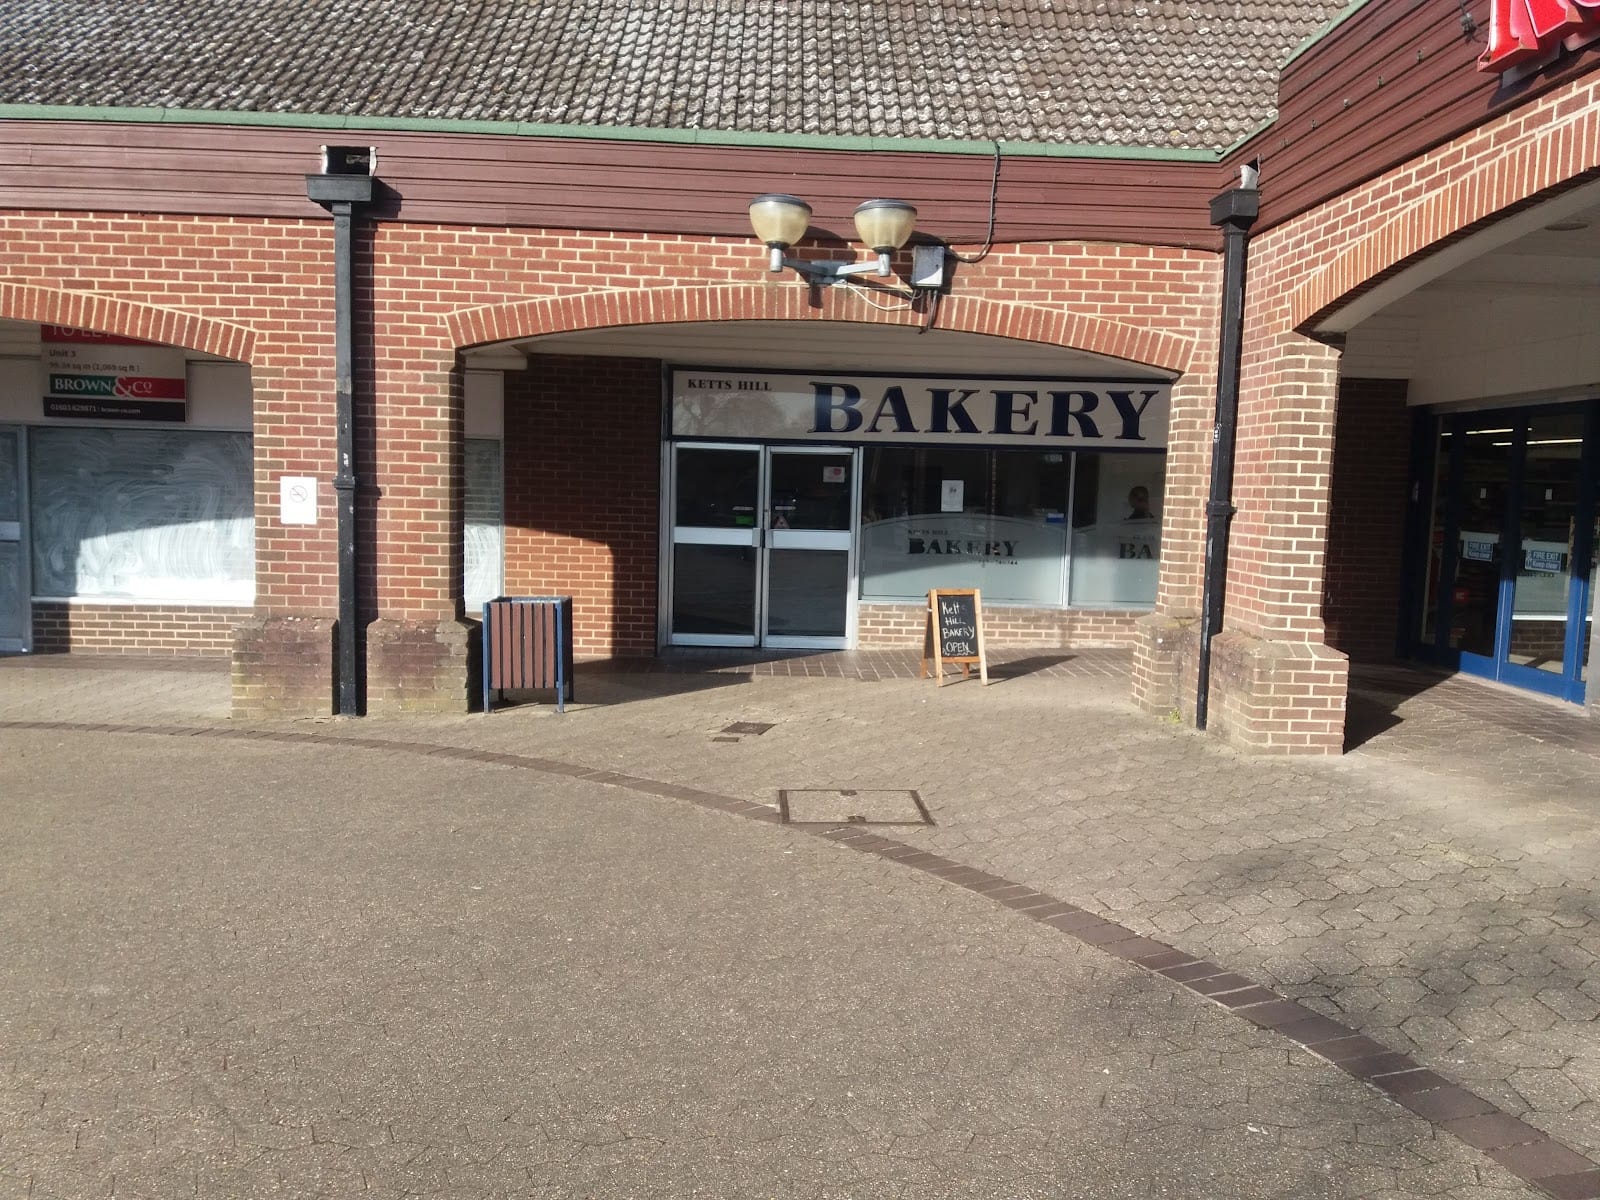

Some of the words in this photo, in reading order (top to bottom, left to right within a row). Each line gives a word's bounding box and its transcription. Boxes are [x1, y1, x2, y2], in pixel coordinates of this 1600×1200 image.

[49, 350, 67, 358] Unit
[687, 378, 732, 391] KETTS
[737, 381, 772, 392] HILL
[806, 380, 1160, 441] BAKERY
[907, 538, 1018, 556] BAKERY
[1532, 551, 1545, 559] FIRE
[1546, 552, 1559, 560] EXIT
[1532, 560, 1544, 569] Keep
[945, 641, 970, 653] OPEN
